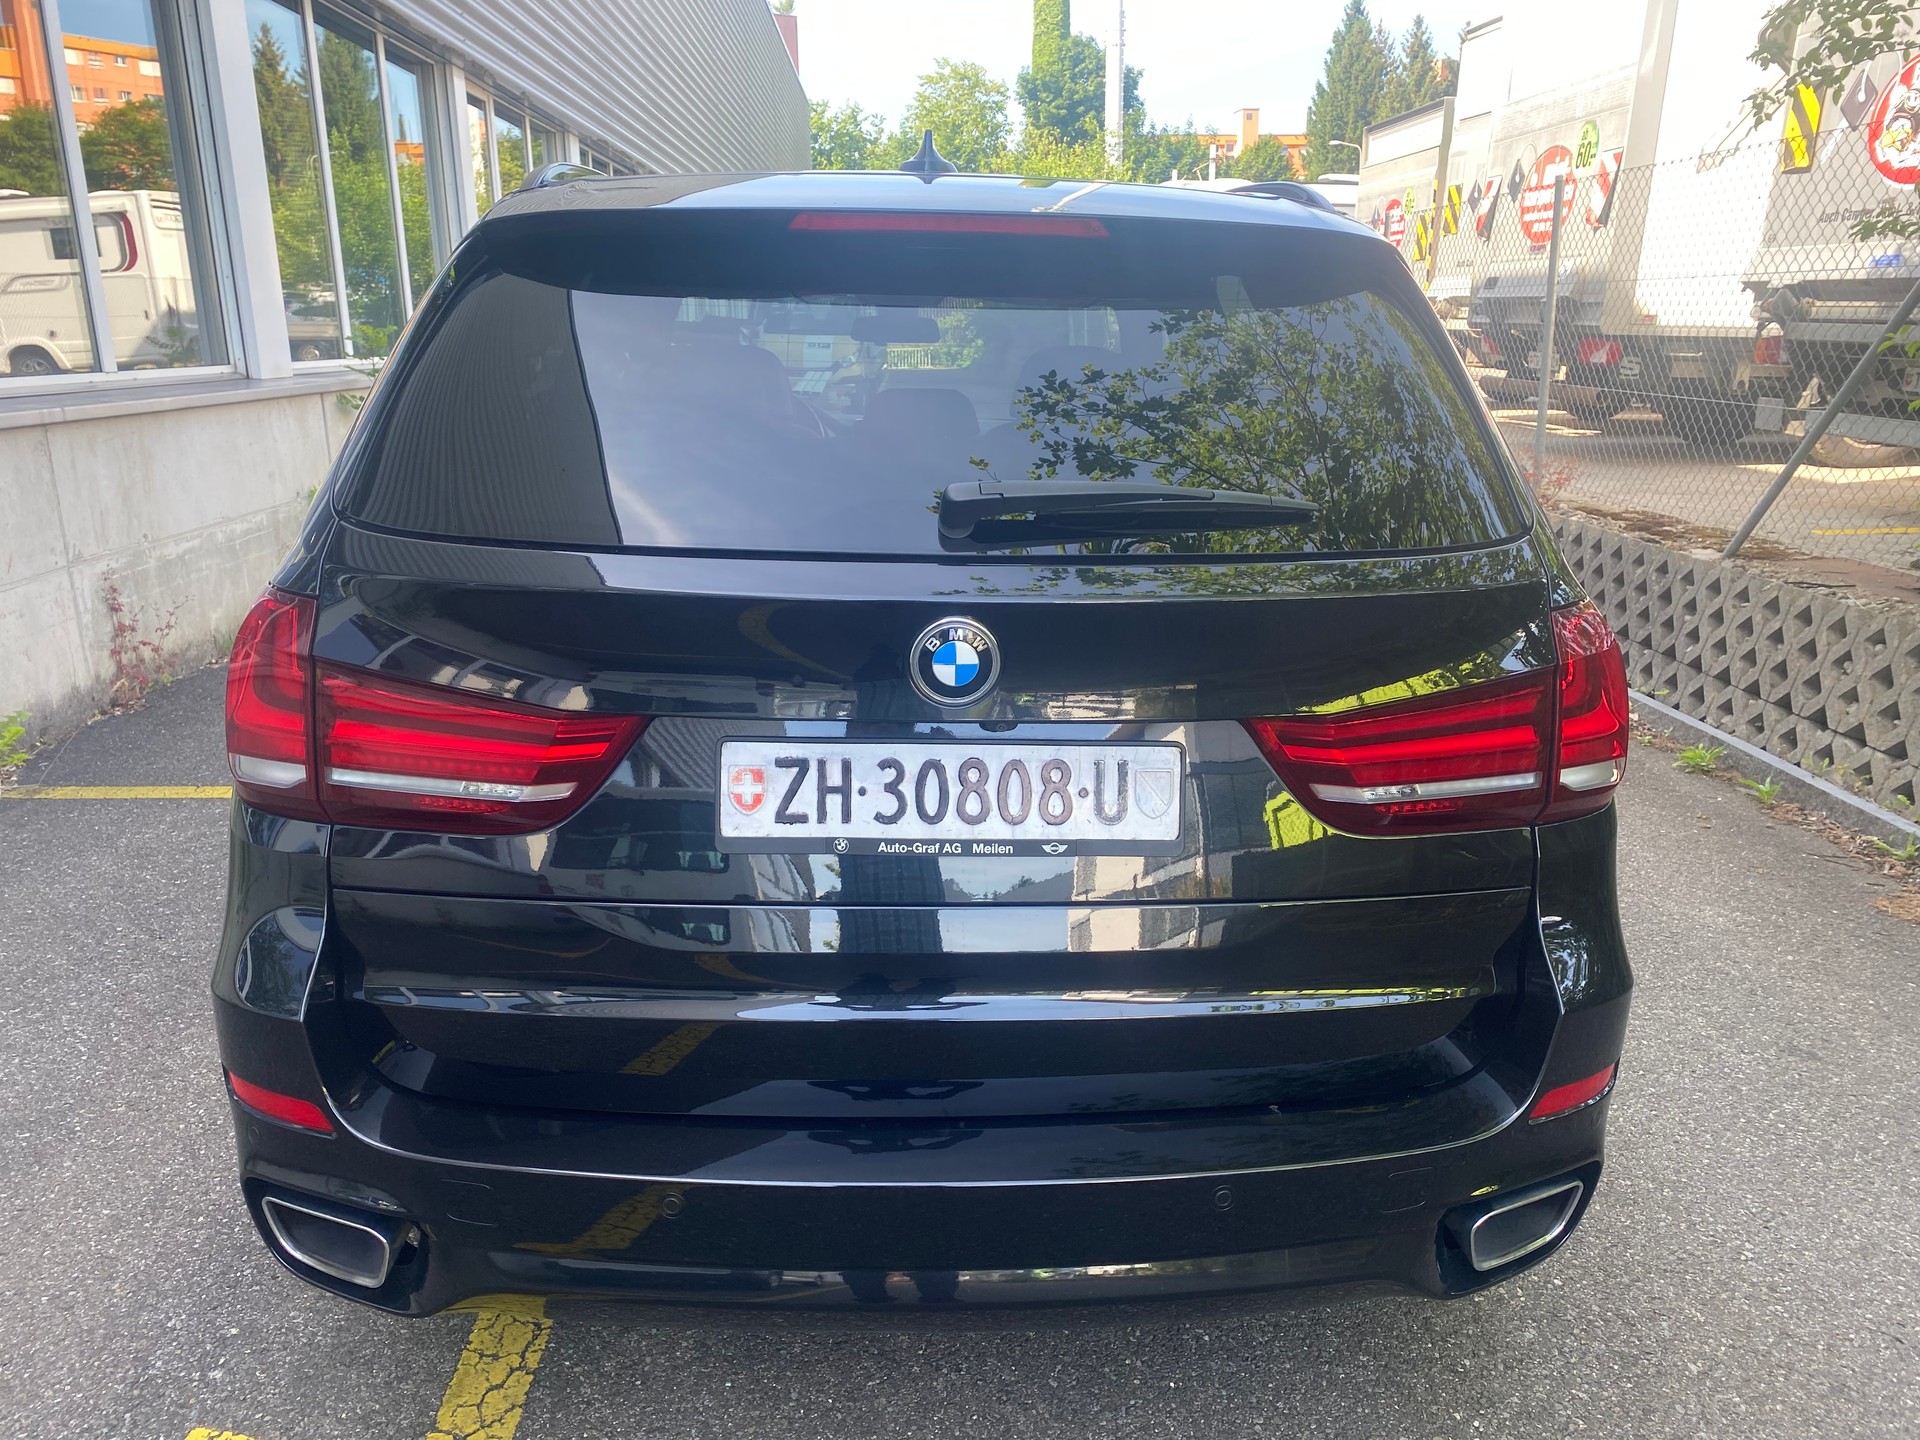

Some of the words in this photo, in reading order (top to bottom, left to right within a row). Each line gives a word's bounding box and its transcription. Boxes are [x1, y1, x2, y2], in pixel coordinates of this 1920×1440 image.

[925, 628, 988, 652] BMW
[877, 841, 940, 854] Auto-Graf
[942, 842, 962, 854] AG
[972, 842, 1014, 854] Meilen
